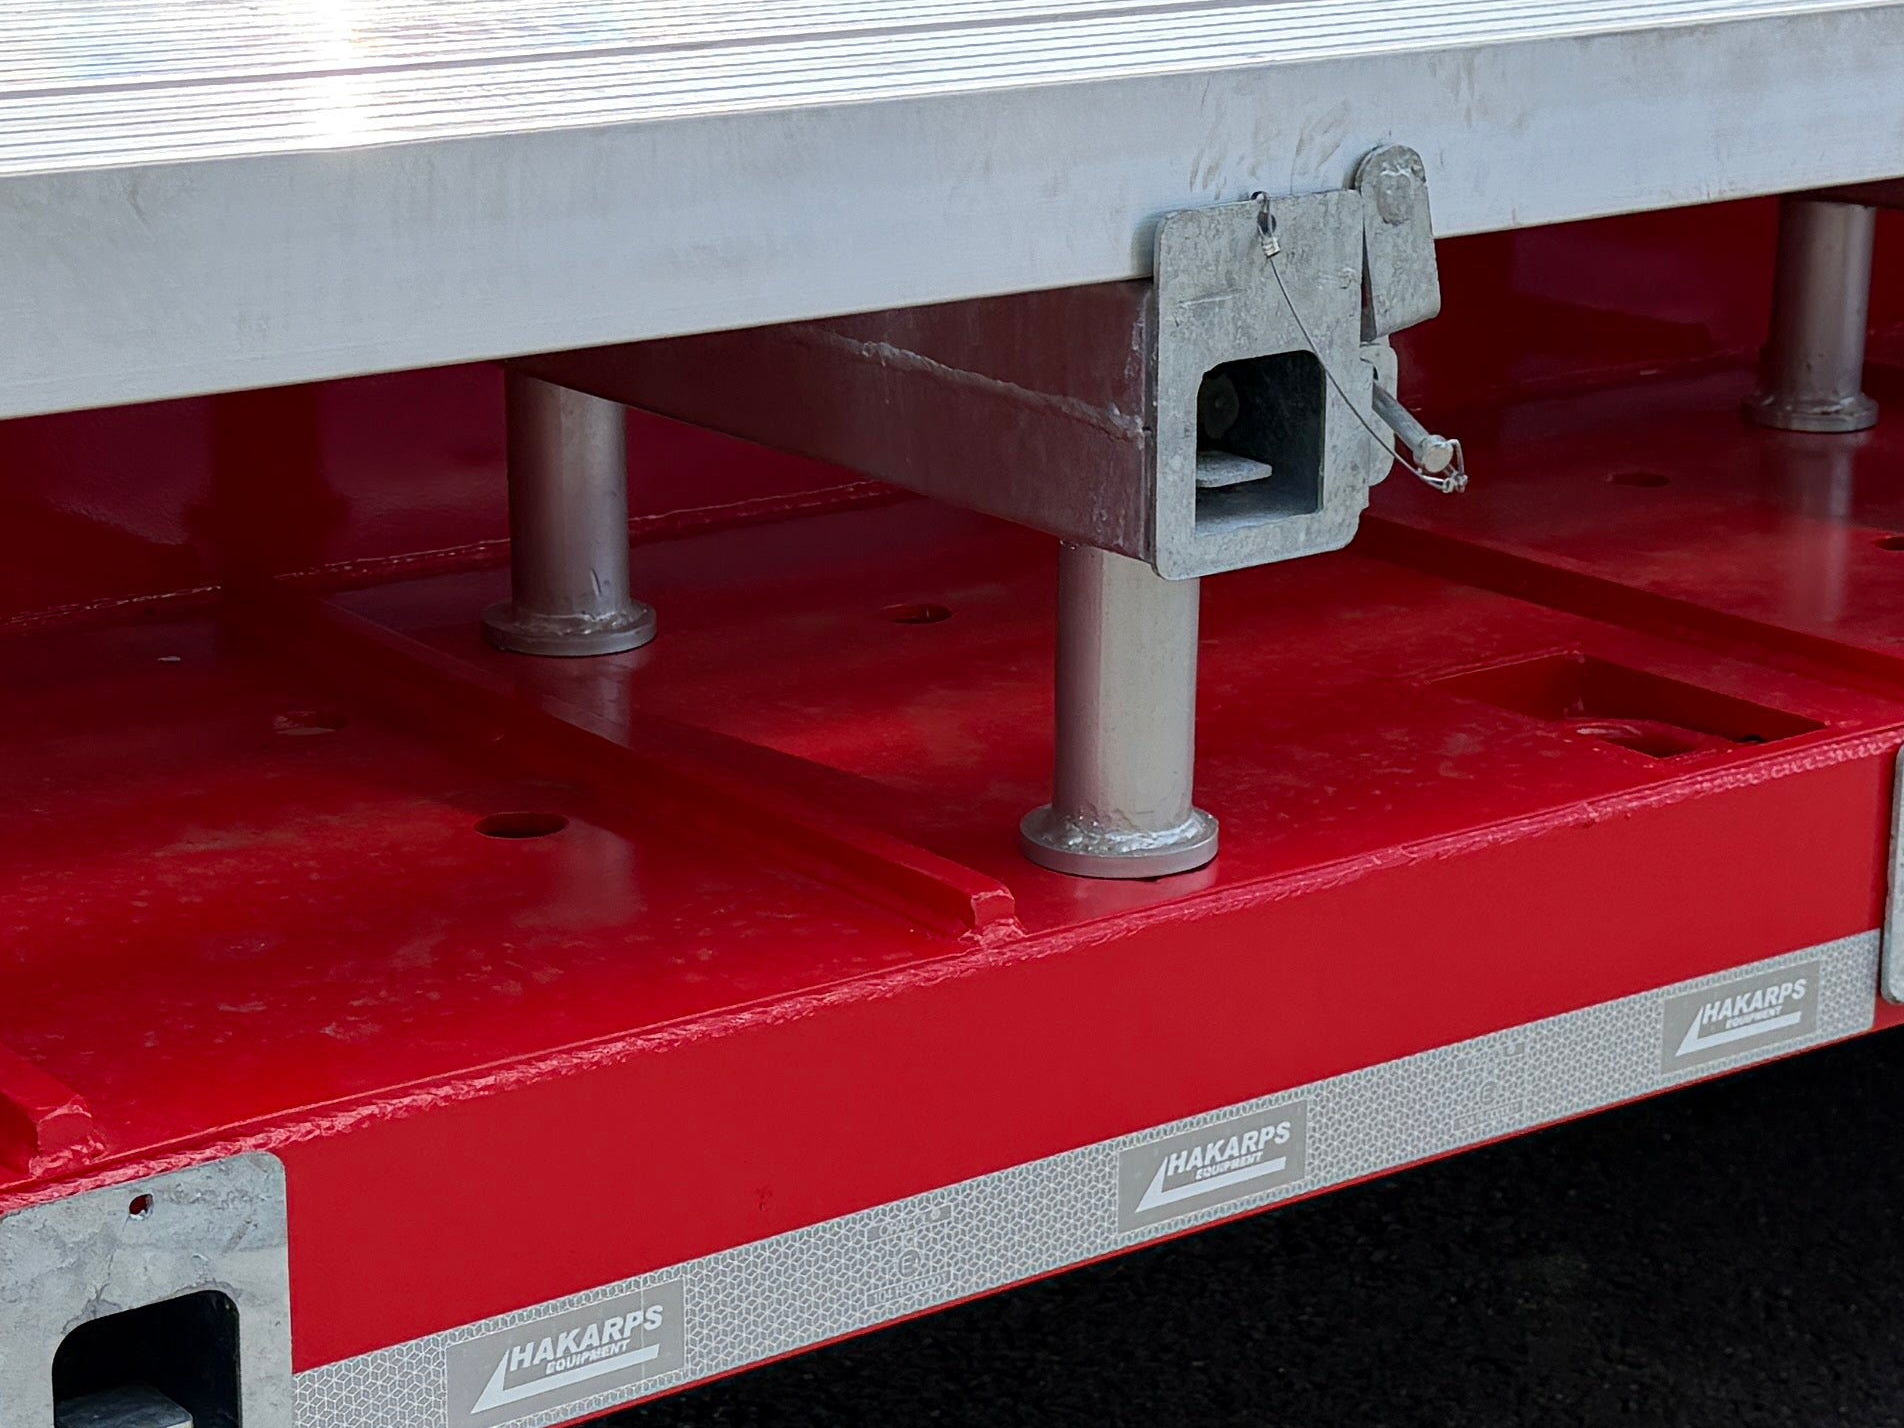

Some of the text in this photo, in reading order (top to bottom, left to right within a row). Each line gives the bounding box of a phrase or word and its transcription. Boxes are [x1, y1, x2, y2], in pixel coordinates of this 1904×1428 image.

[1702, 978, 1807, 1024] HAKARPS
[1167, 1121, 1291, 1177] HAKARPS
[508, 1304, 664, 1372] HAKARPS
[545, 1339, 631, 1374] EQUIPMENT
